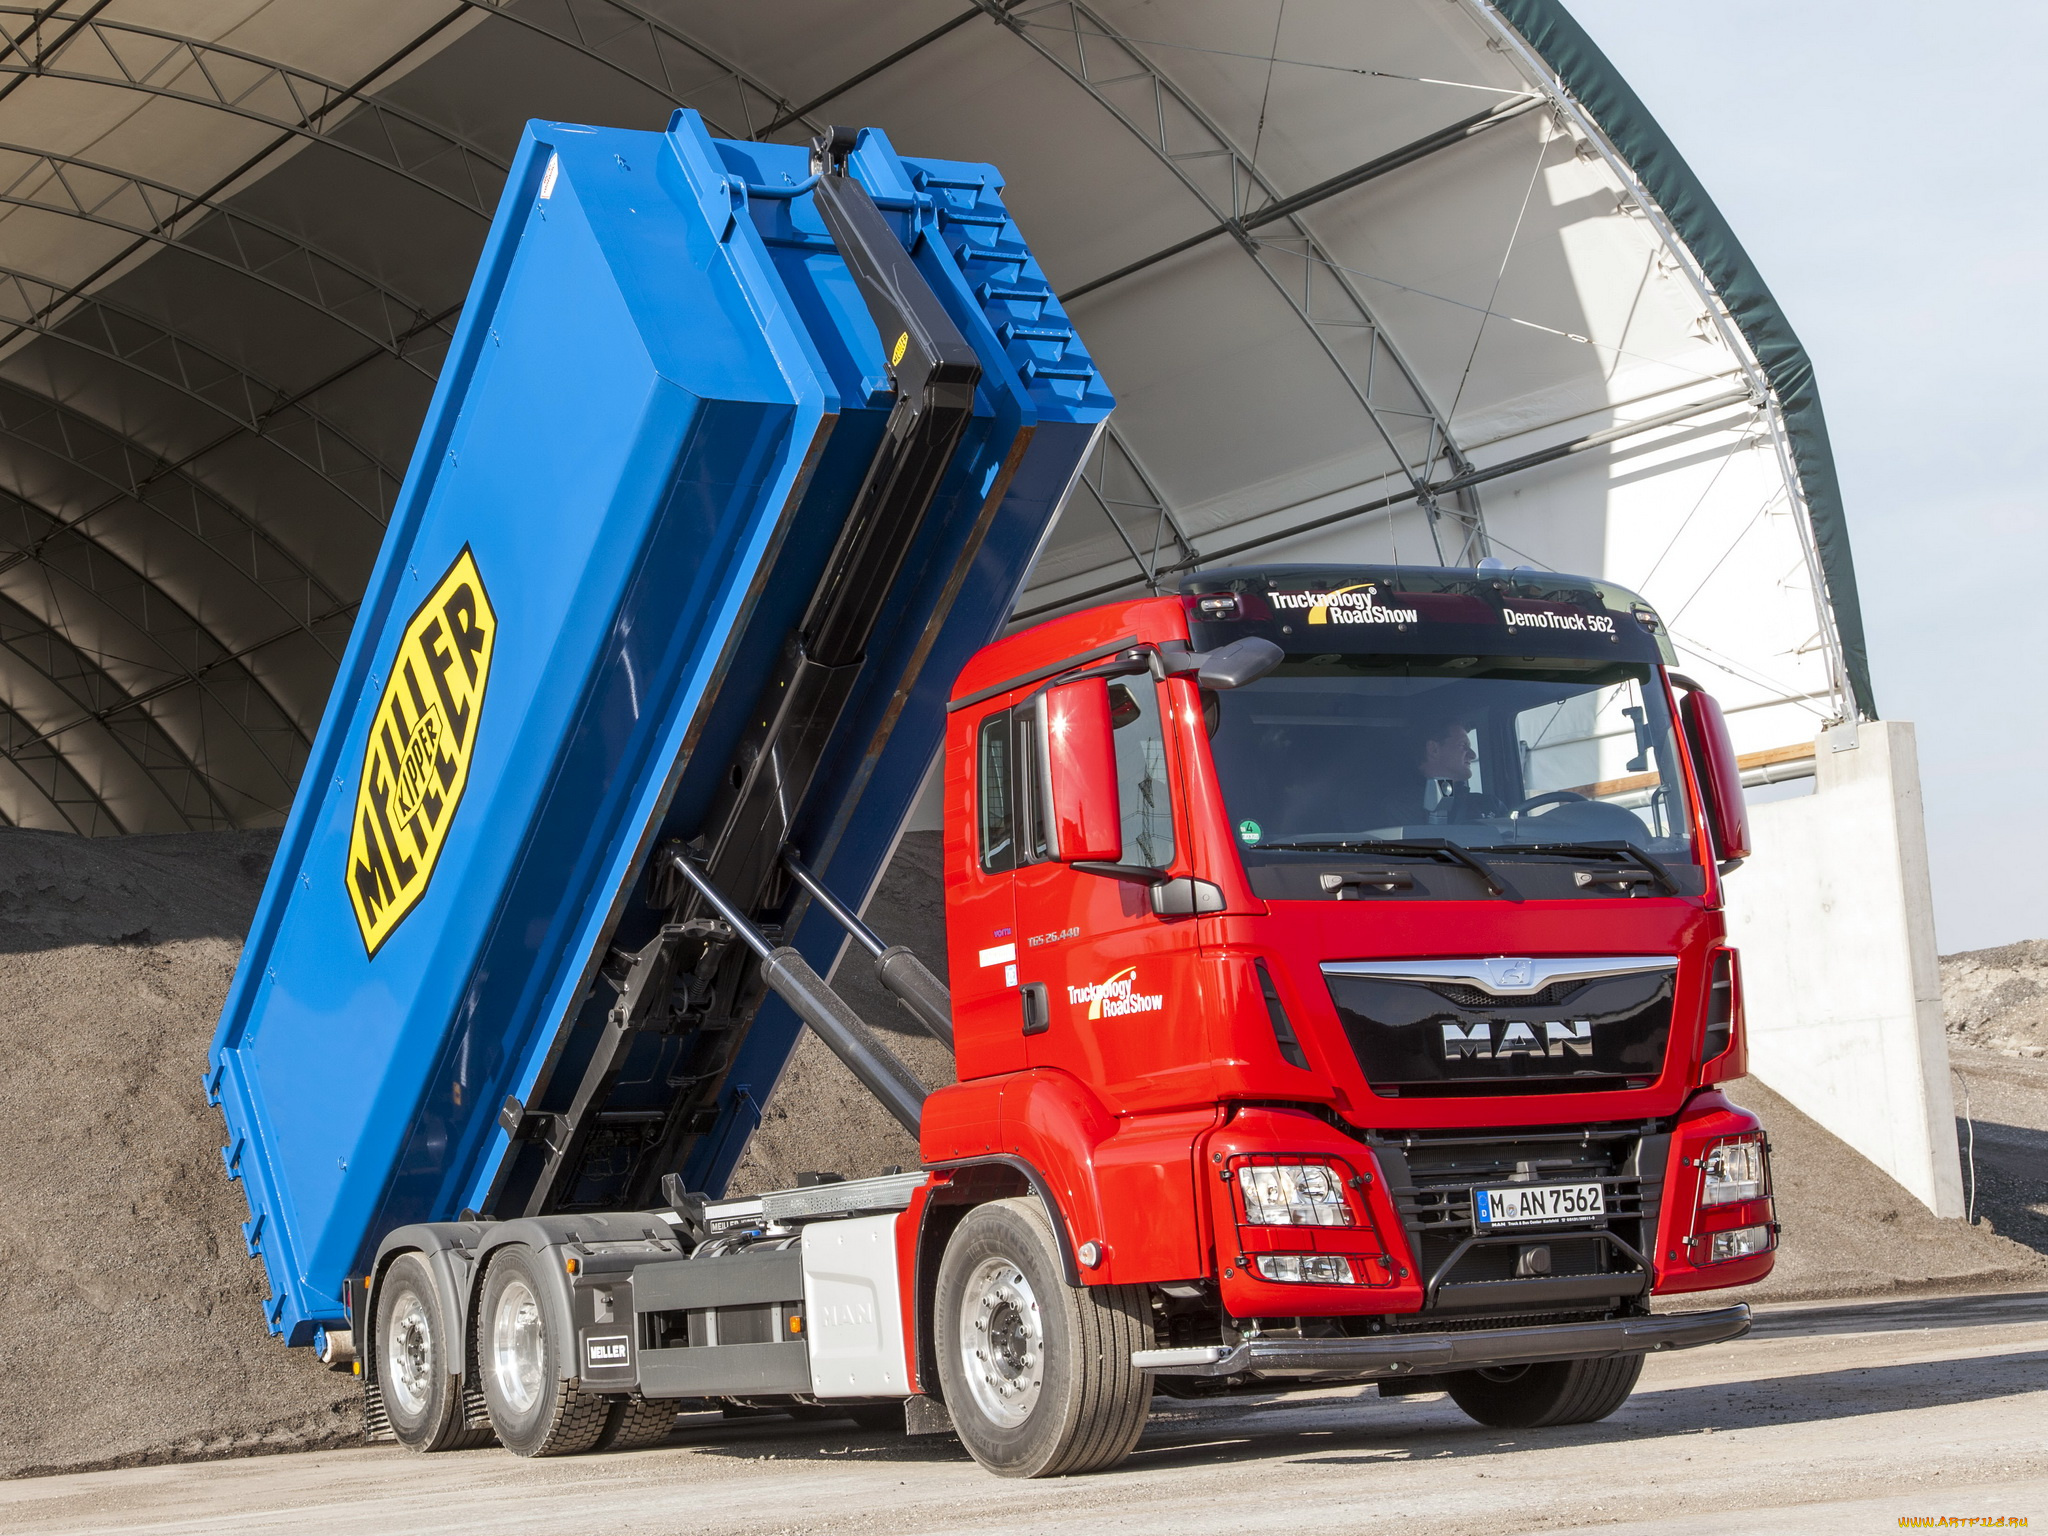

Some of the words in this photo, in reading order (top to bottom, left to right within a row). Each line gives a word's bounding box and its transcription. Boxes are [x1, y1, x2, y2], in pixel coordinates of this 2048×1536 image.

[1329, 605, 1418, 624] RoadShow
[1503, 608, 1588, 631] DemoTruck
[1586, 615, 1616, 633] 562
[398, 716, 438, 819] KIPPER
[1246, 822, 1253, 833] 4
[1027, 935, 1044, 947] TGS
[1045, 926, 1080, 944] 26.440
[1102, 993, 1163, 1018] RoadShow
[1441, 1020, 1594, 1060] MAN
[1481, 1209, 1488, 1217] D
[1490, 1193, 1505, 1218] M
[1520, 1190, 1546, 1216] AN
[1549, 1187, 1601, 1214] 7562
[822, 1303, 872, 1327] MAN
[590, 1344, 626, 1359] MEILLER
